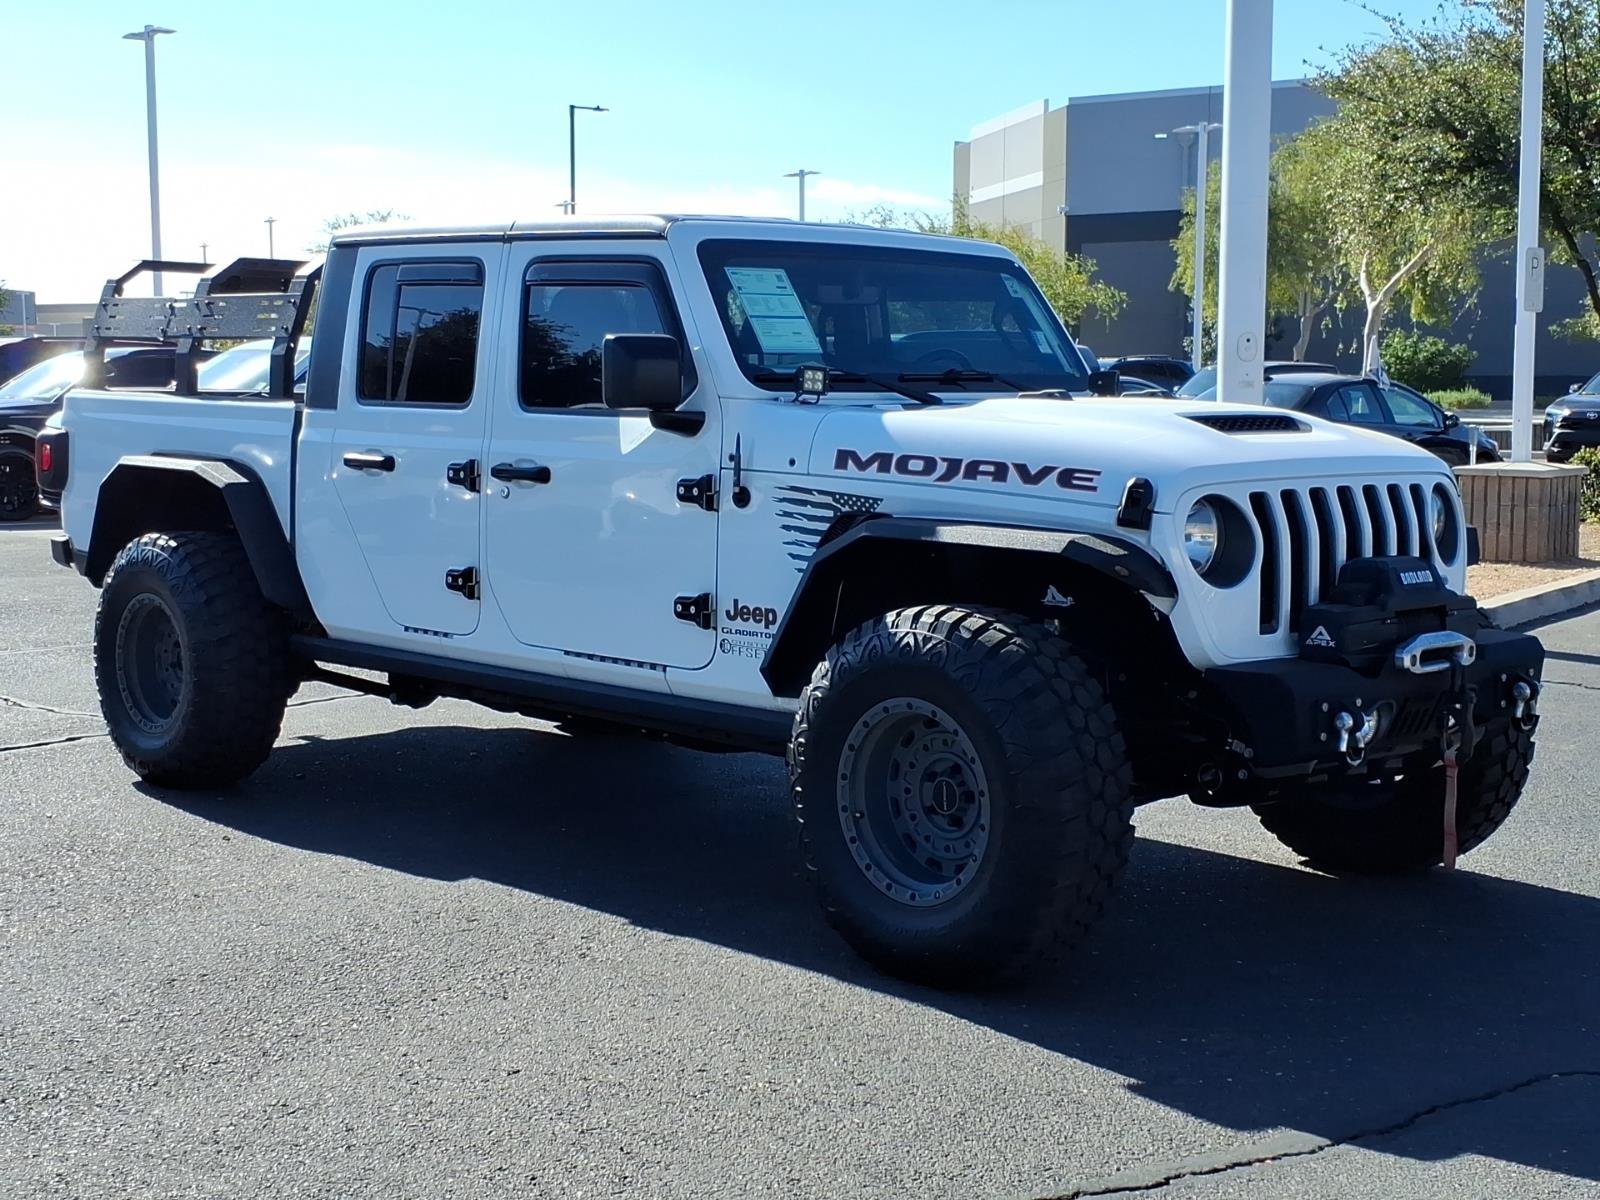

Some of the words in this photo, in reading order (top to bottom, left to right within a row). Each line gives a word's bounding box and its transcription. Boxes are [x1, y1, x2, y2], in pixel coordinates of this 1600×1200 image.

[833, 448, 1102, 493] MOJAVE
[1400, 570, 1433, 585] BADLAND
[725, 598, 777, 629] Jeep
[1305, 638, 1336, 647] APEX
